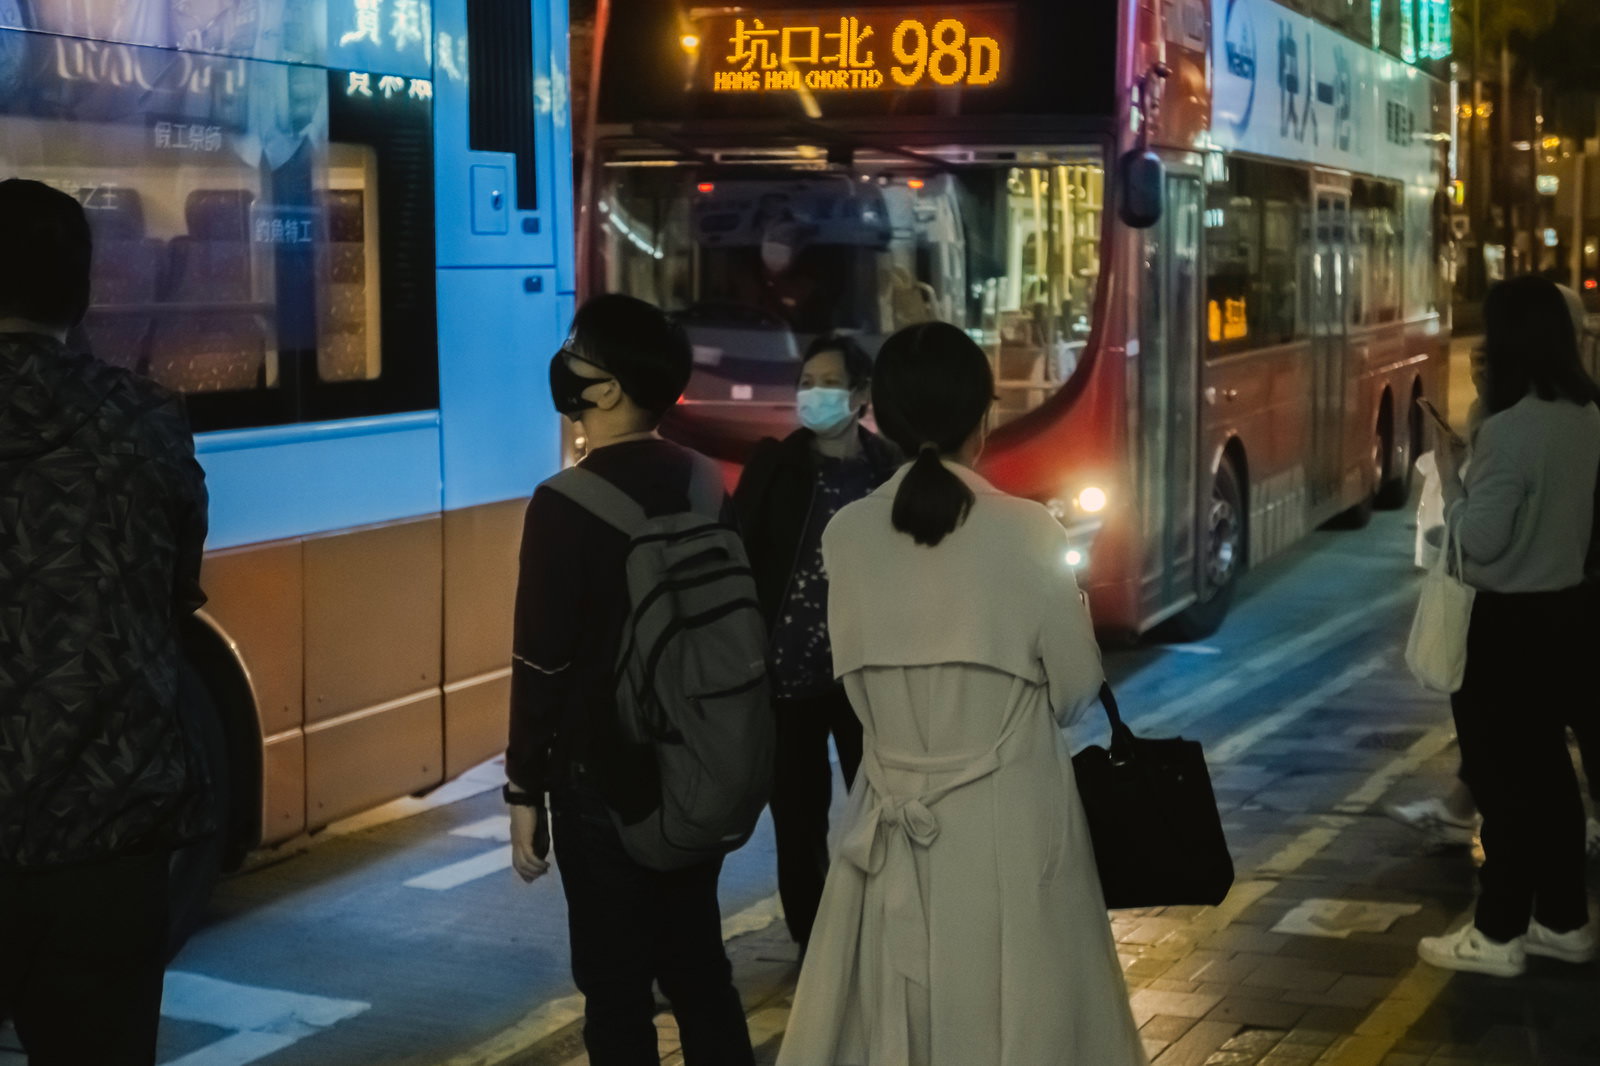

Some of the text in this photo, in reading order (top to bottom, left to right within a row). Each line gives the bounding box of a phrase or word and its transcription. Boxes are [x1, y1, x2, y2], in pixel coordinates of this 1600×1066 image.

[726, 16, 874, 71] 坑口北
[890, 18, 1001, 86] 98D
[713, 71, 760, 91] HANG
[764, 70, 801, 91] HAU
